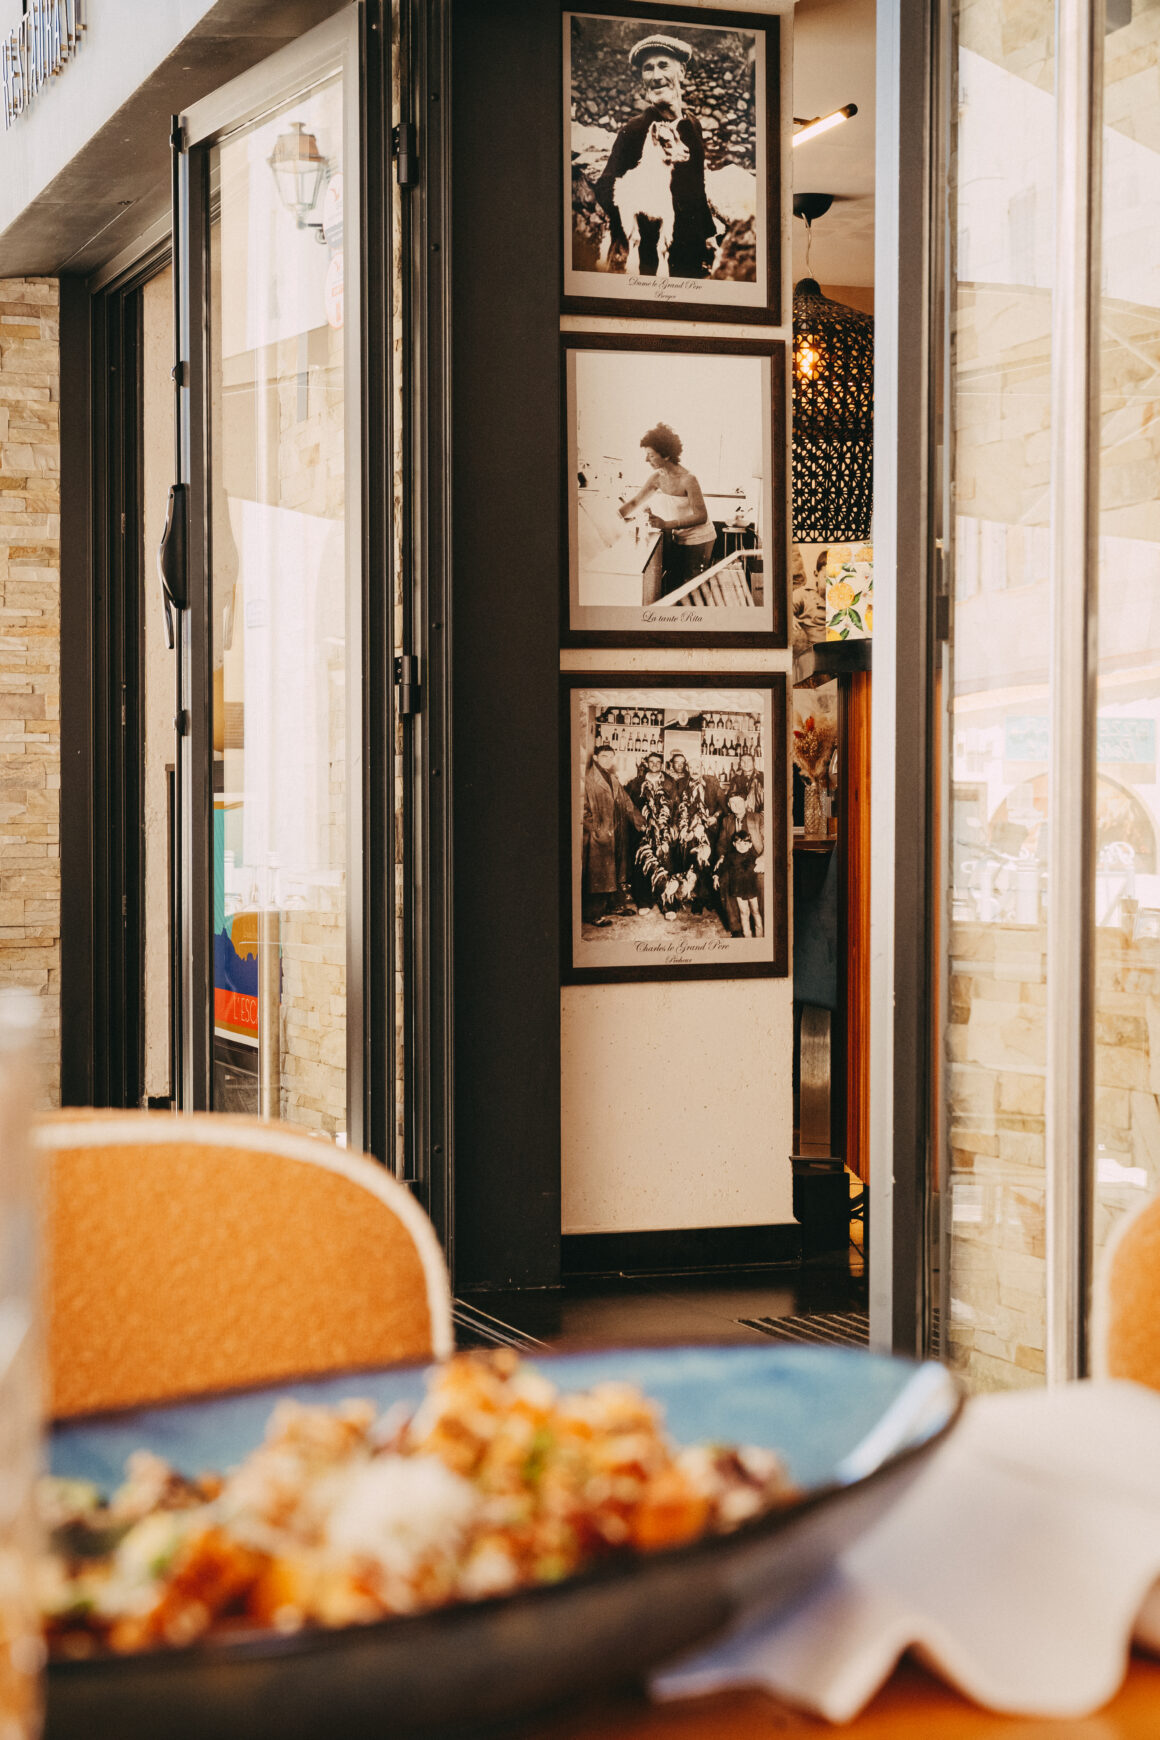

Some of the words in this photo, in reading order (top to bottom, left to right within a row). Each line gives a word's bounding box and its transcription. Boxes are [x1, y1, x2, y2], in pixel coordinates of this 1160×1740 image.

[641, 611, 657, 622] La
[658, 614, 678, 622] tante
[681, 611, 703, 622] Rita
[634, 941, 666, 953] Charles
[666, 942, 675, 951] le
[675, 939, 707, 953] Grand
